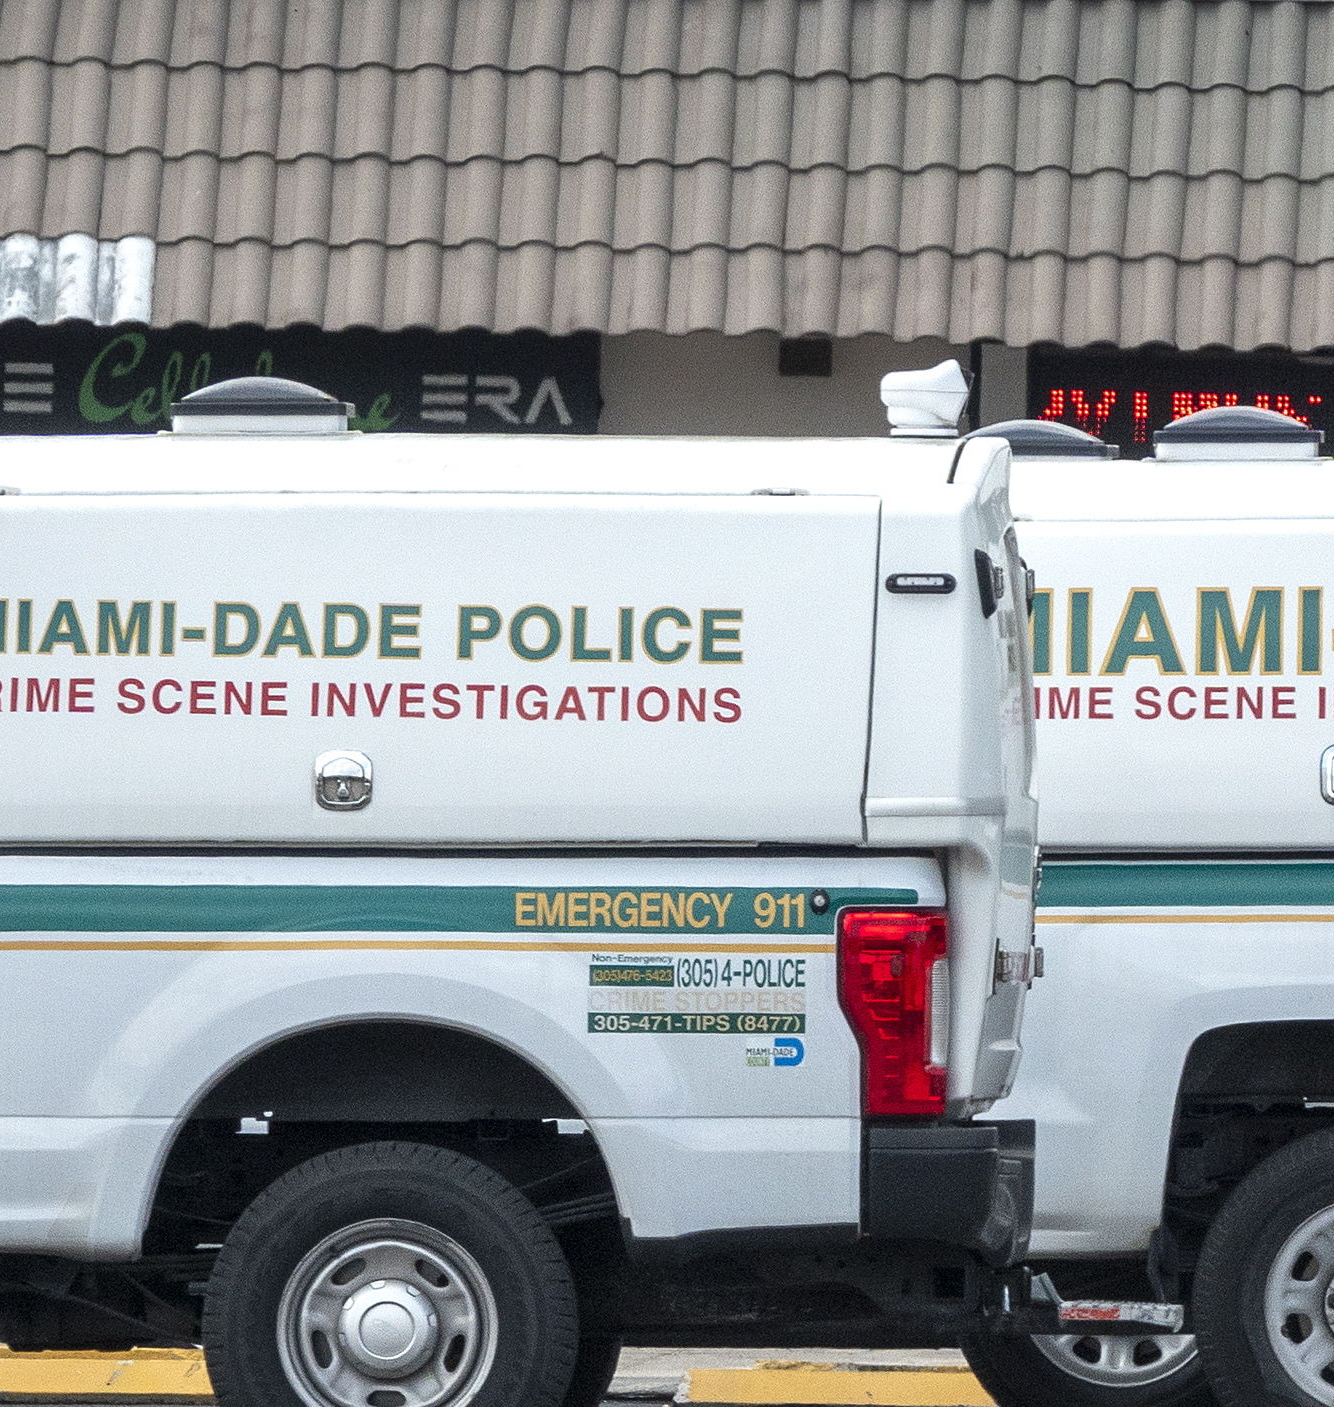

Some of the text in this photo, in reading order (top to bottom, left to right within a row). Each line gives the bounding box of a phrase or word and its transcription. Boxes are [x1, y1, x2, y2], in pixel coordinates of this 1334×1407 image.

[78, 332, 401, 432] Celle
[421, 373, 573, 426] ERA
[456, 604, 744, 665] POLICE
[117, 678, 287, 717] SCENE
[310, 682, 743, 723] INVESTIGATIONS
[1134, 685, 1297, 720] SCENE
[515, 891, 805, 928] EMERGENCY 911
[592, 954, 673, 964] Non-Emergency
[588, 990, 806, 1012] CRIME STOPPERS
[594, 1015, 801, 1032] 305-471-TIPS (8477)
[746, 1048, 794, 1056] MIAMI-DADE
